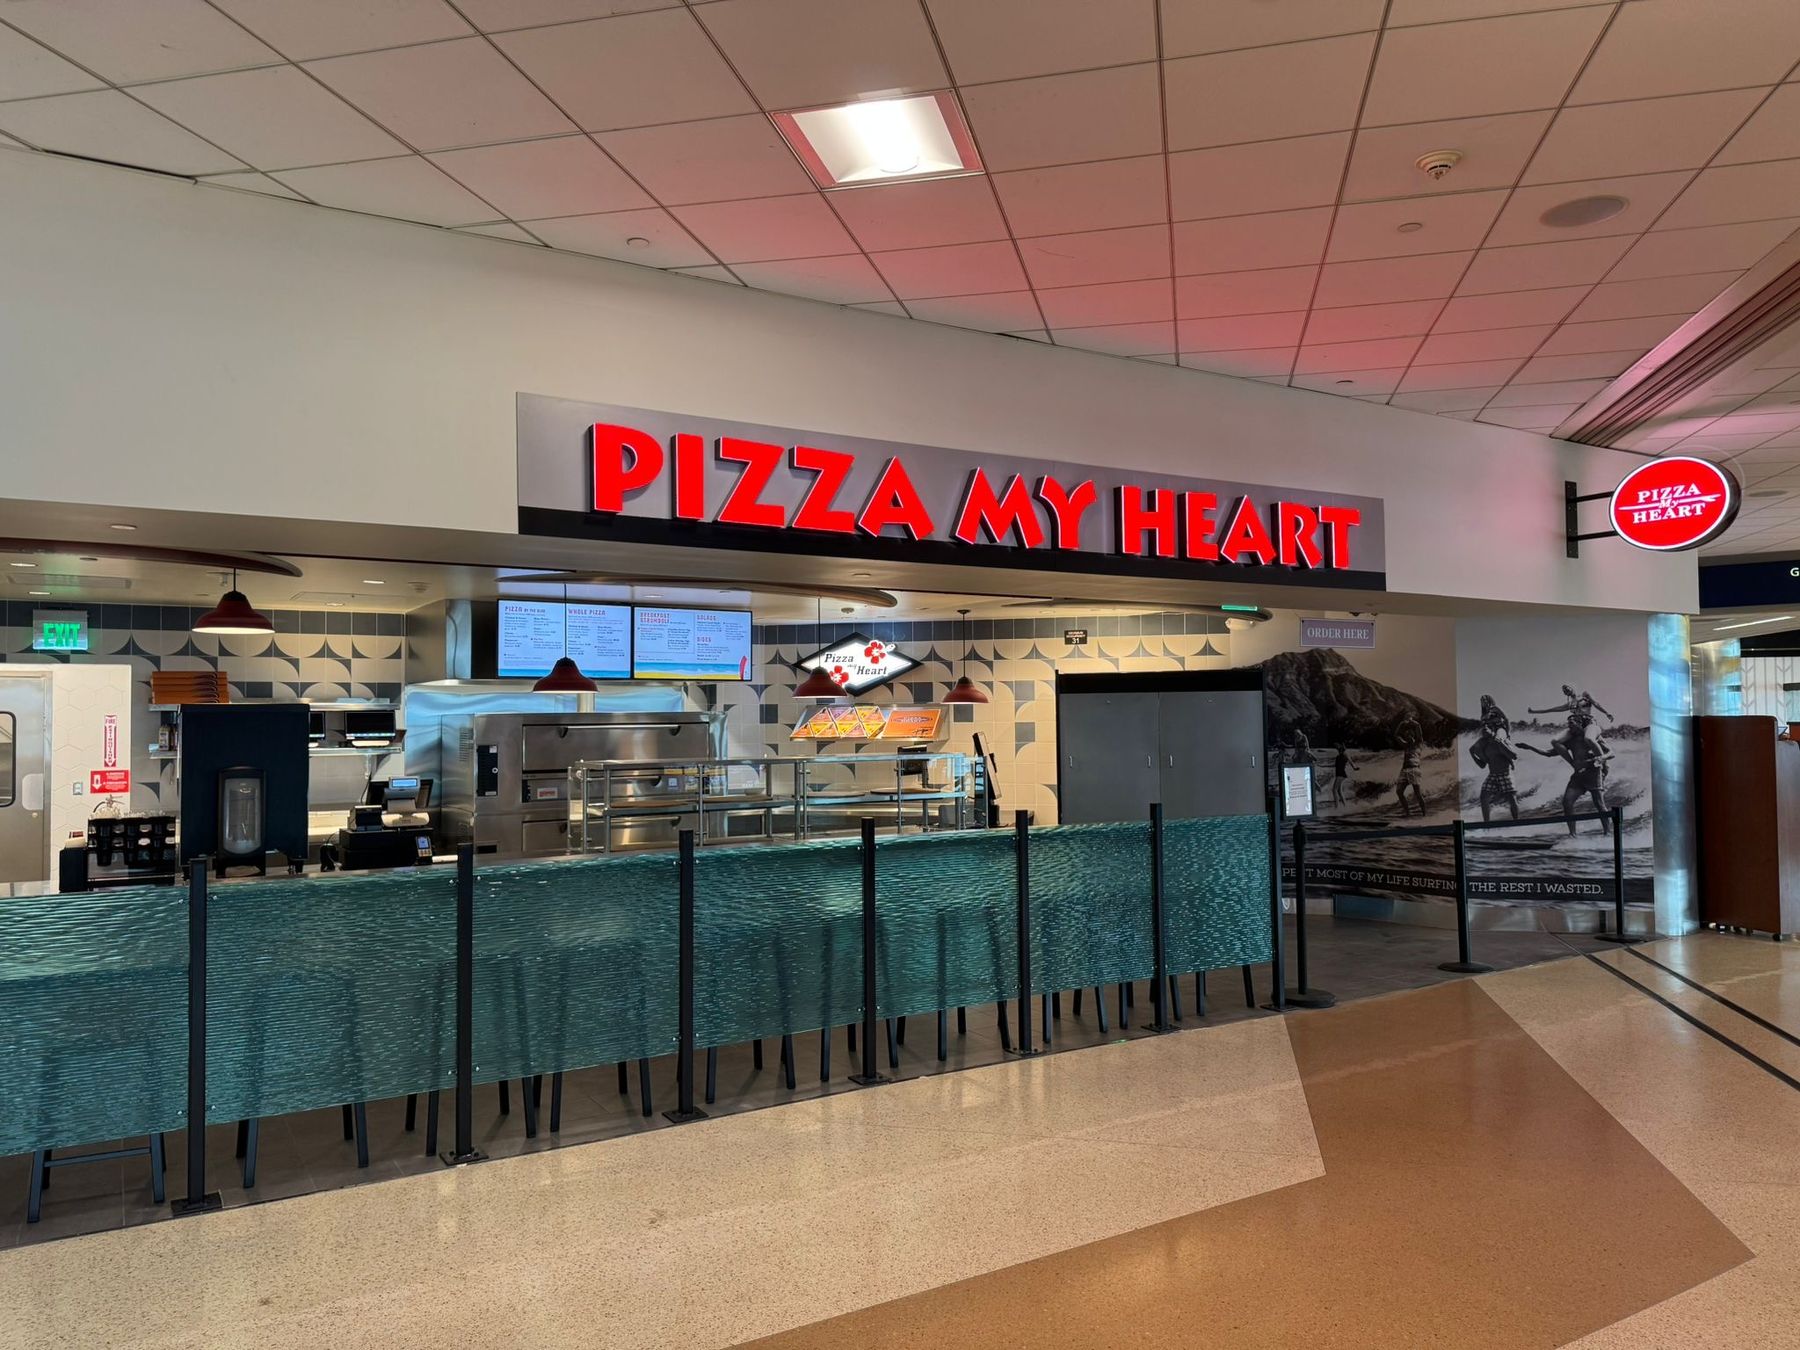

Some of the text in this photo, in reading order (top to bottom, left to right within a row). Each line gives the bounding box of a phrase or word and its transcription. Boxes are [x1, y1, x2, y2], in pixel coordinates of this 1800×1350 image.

[590, 422, 1360, 569] PIZZA MY HEART
[1637, 483, 1702, 503] PIZZA
[1632, 502, 1706, 524] HEART
[43, 622, 81, 648] EXIT
[1307, 627, 1369, 640] ORDER HERE
[824, 653, 854, 663] Pizza
[856, 665, 888, 676] Heart
[1282, 867, 1314, 878] PET
[1316, 869, 1347, 880] MOST
[1351, 871, 1364, 881] OF
[1369, 873, 1384, 884] MY
[1386, 875, 1410, 886] LIFE
[1469, 882, 1496, 893] THE
[1500, 882, 1534, 893] REST
[1537, 883, 1541, 893] I
[1544, 883, 1604, 895] WASTED.
